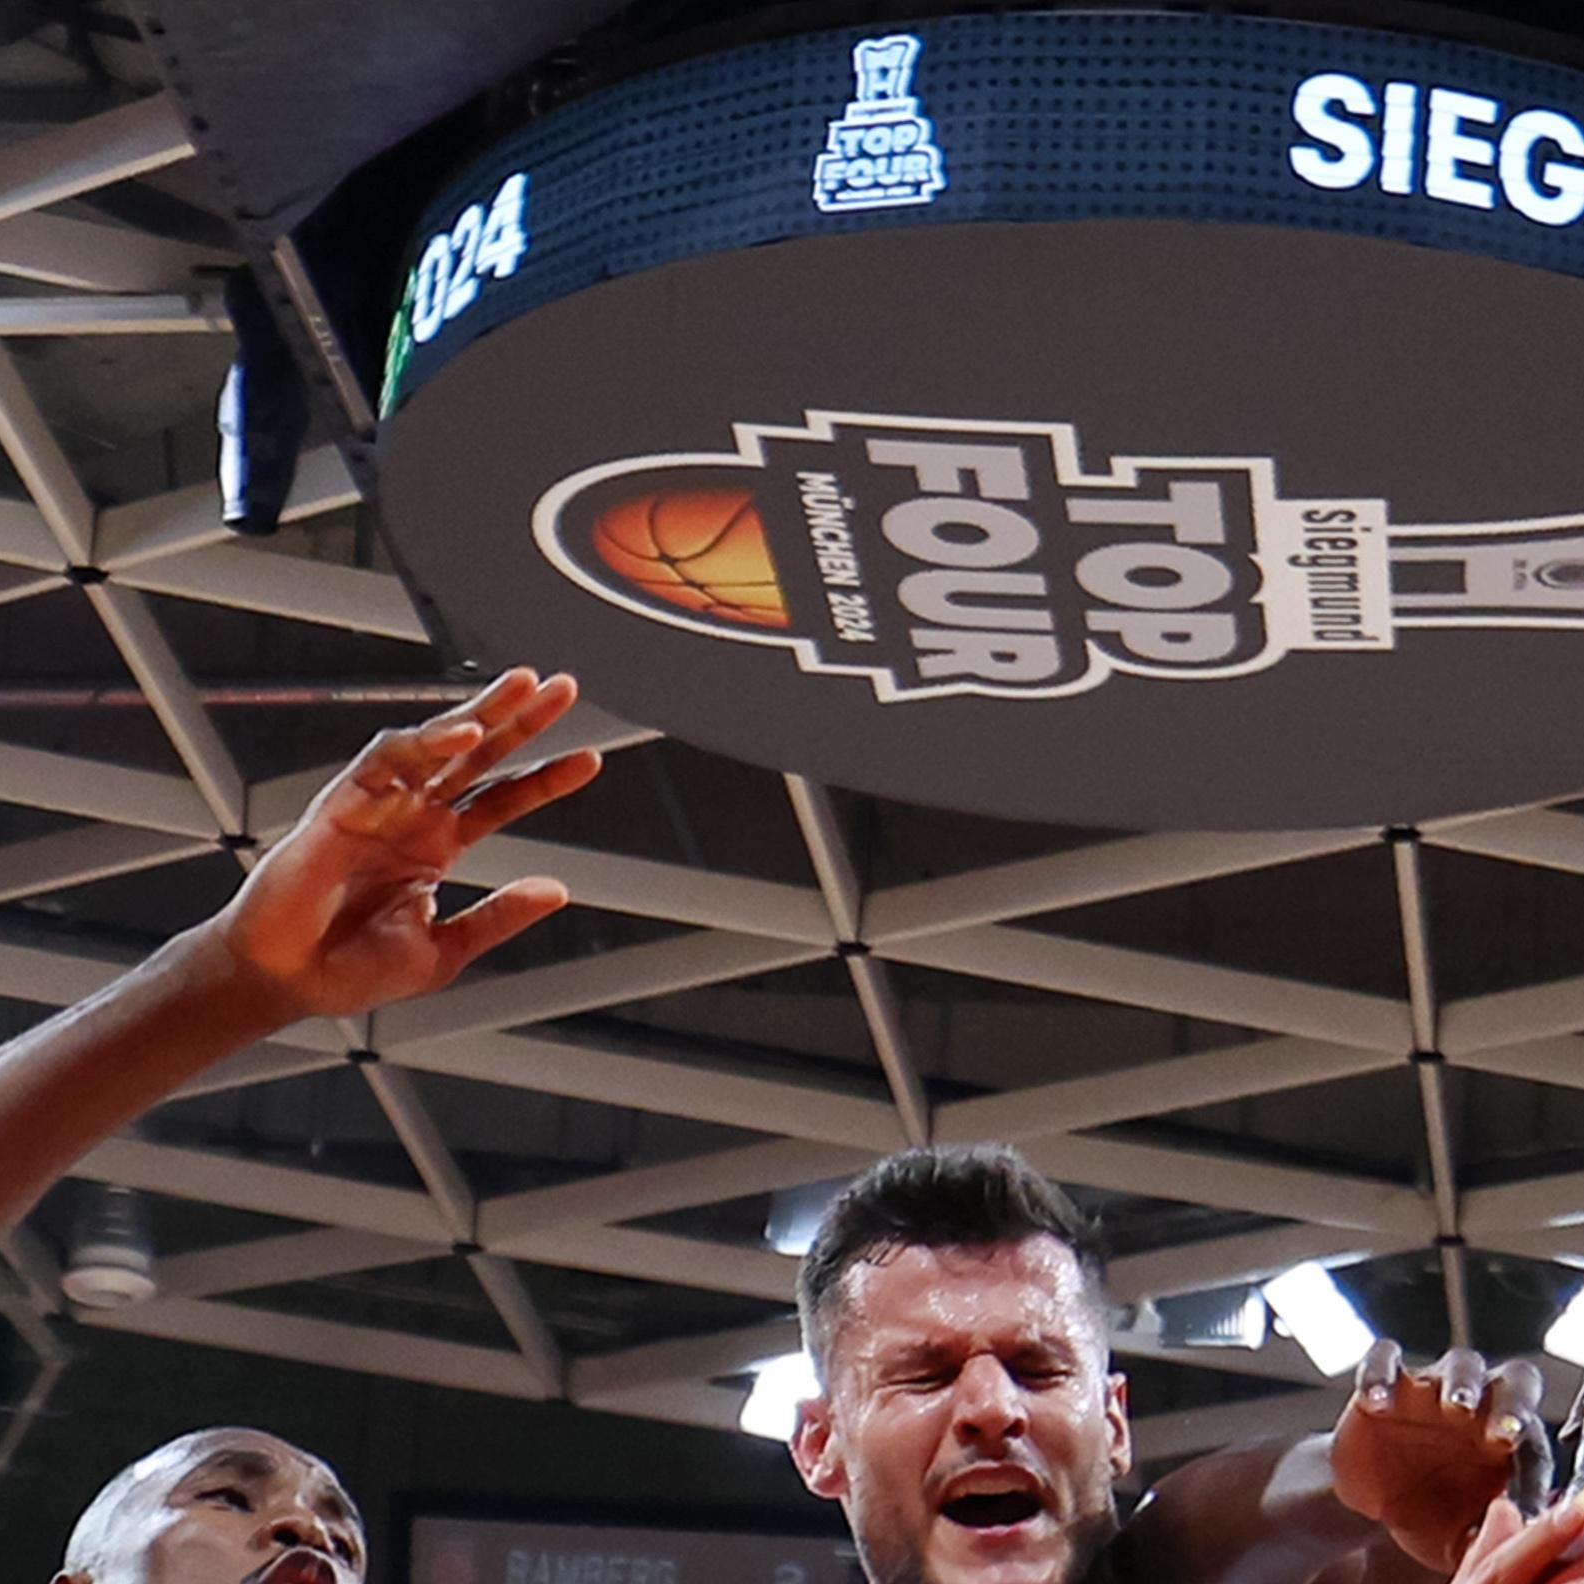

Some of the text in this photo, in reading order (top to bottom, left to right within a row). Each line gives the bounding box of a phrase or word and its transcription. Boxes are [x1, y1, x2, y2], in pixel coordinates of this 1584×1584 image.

[796, 471, 877, 643] MÜNCHEN 2024
[865, 438, 1062, 682] FOUR
[1065, 481, 1237, 663] TOP
[1288, 509, 1380, 643] siegmund
